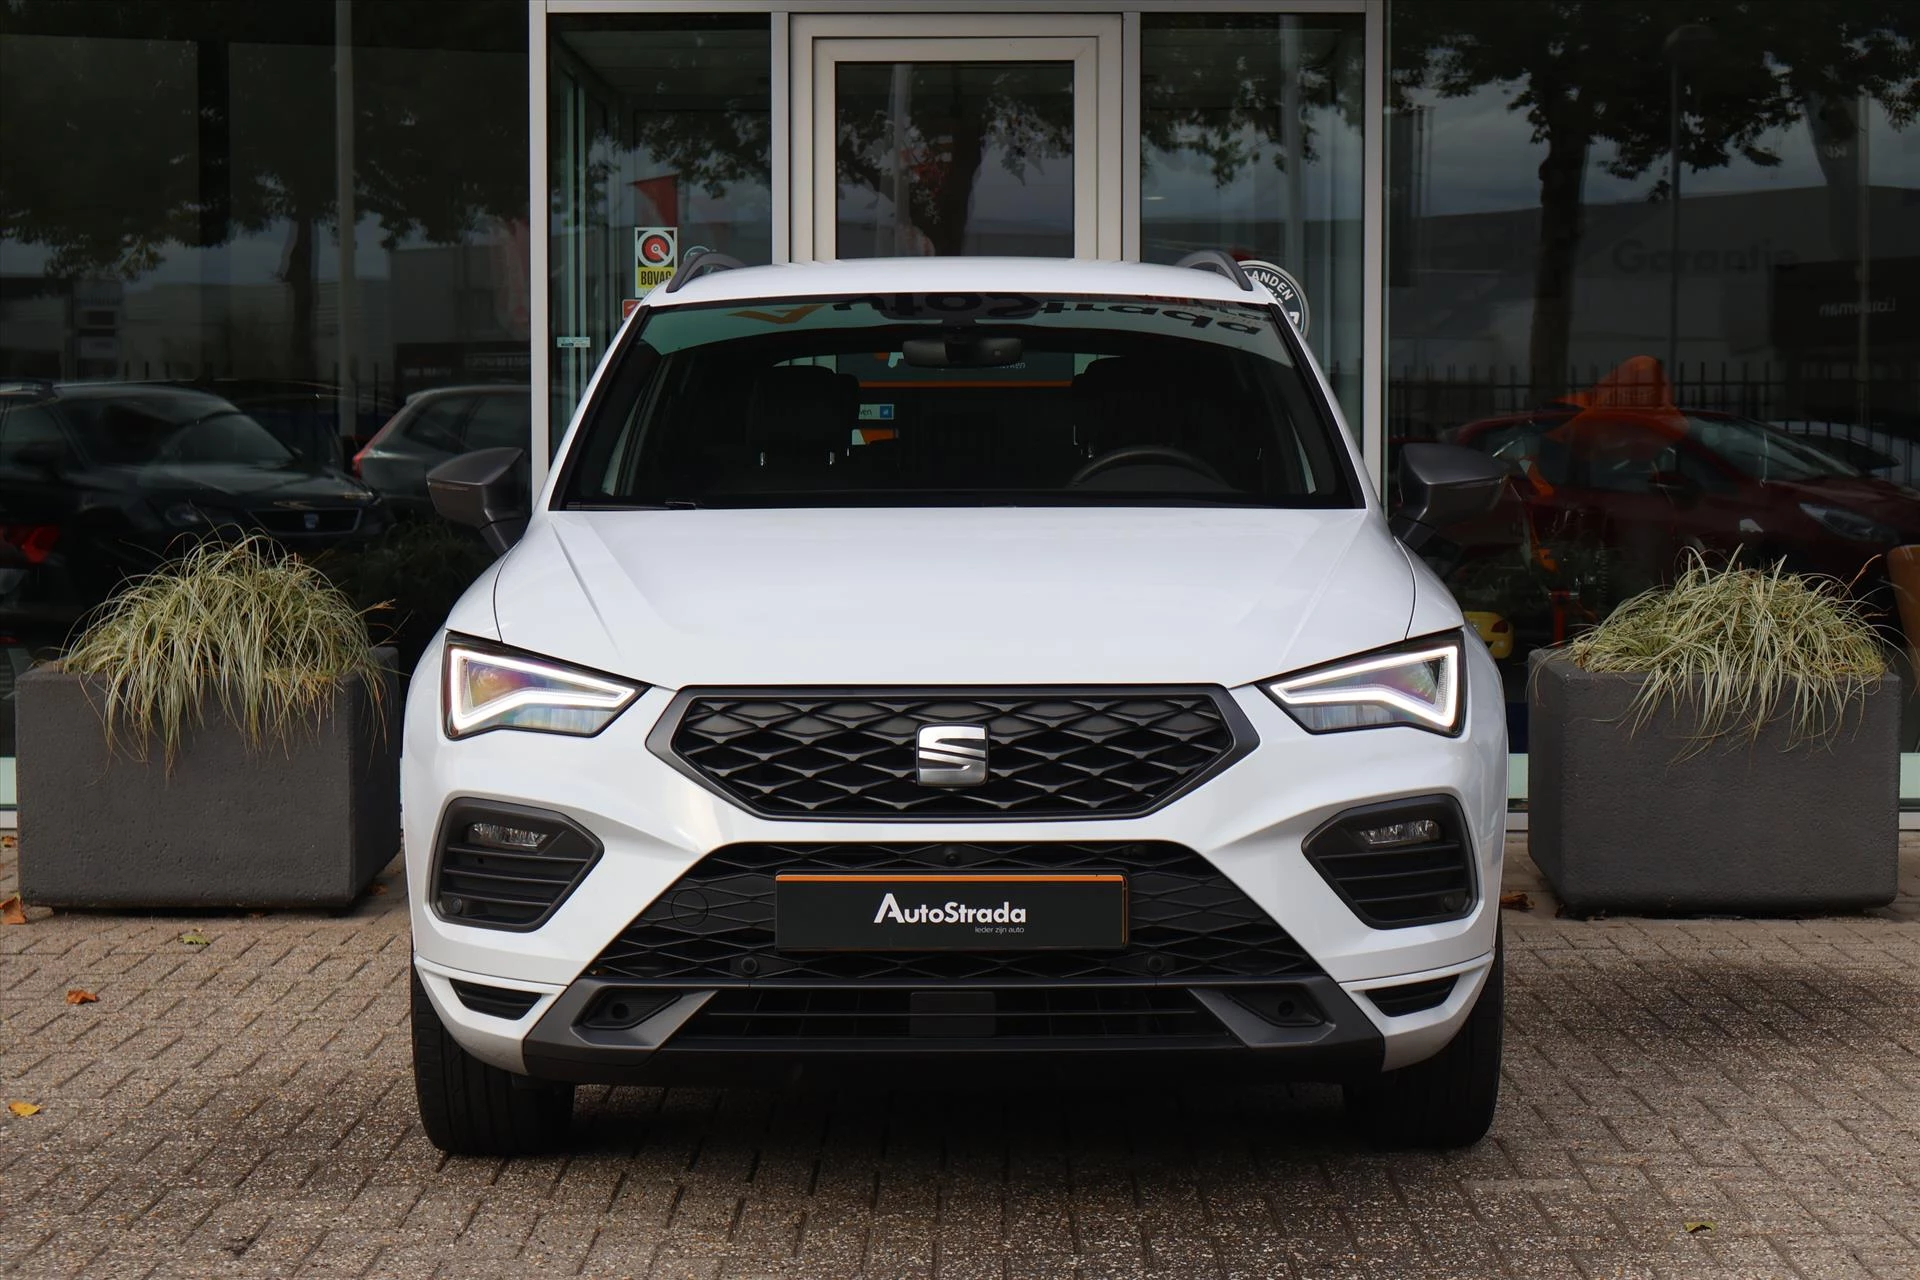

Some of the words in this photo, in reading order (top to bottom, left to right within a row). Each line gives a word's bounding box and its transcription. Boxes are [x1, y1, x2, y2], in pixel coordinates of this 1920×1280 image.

[873, 893, 1027, 923] AutoStrada
[995, 925, 1007, 936] zijn
[1008, 926, 1025, 934] auto
